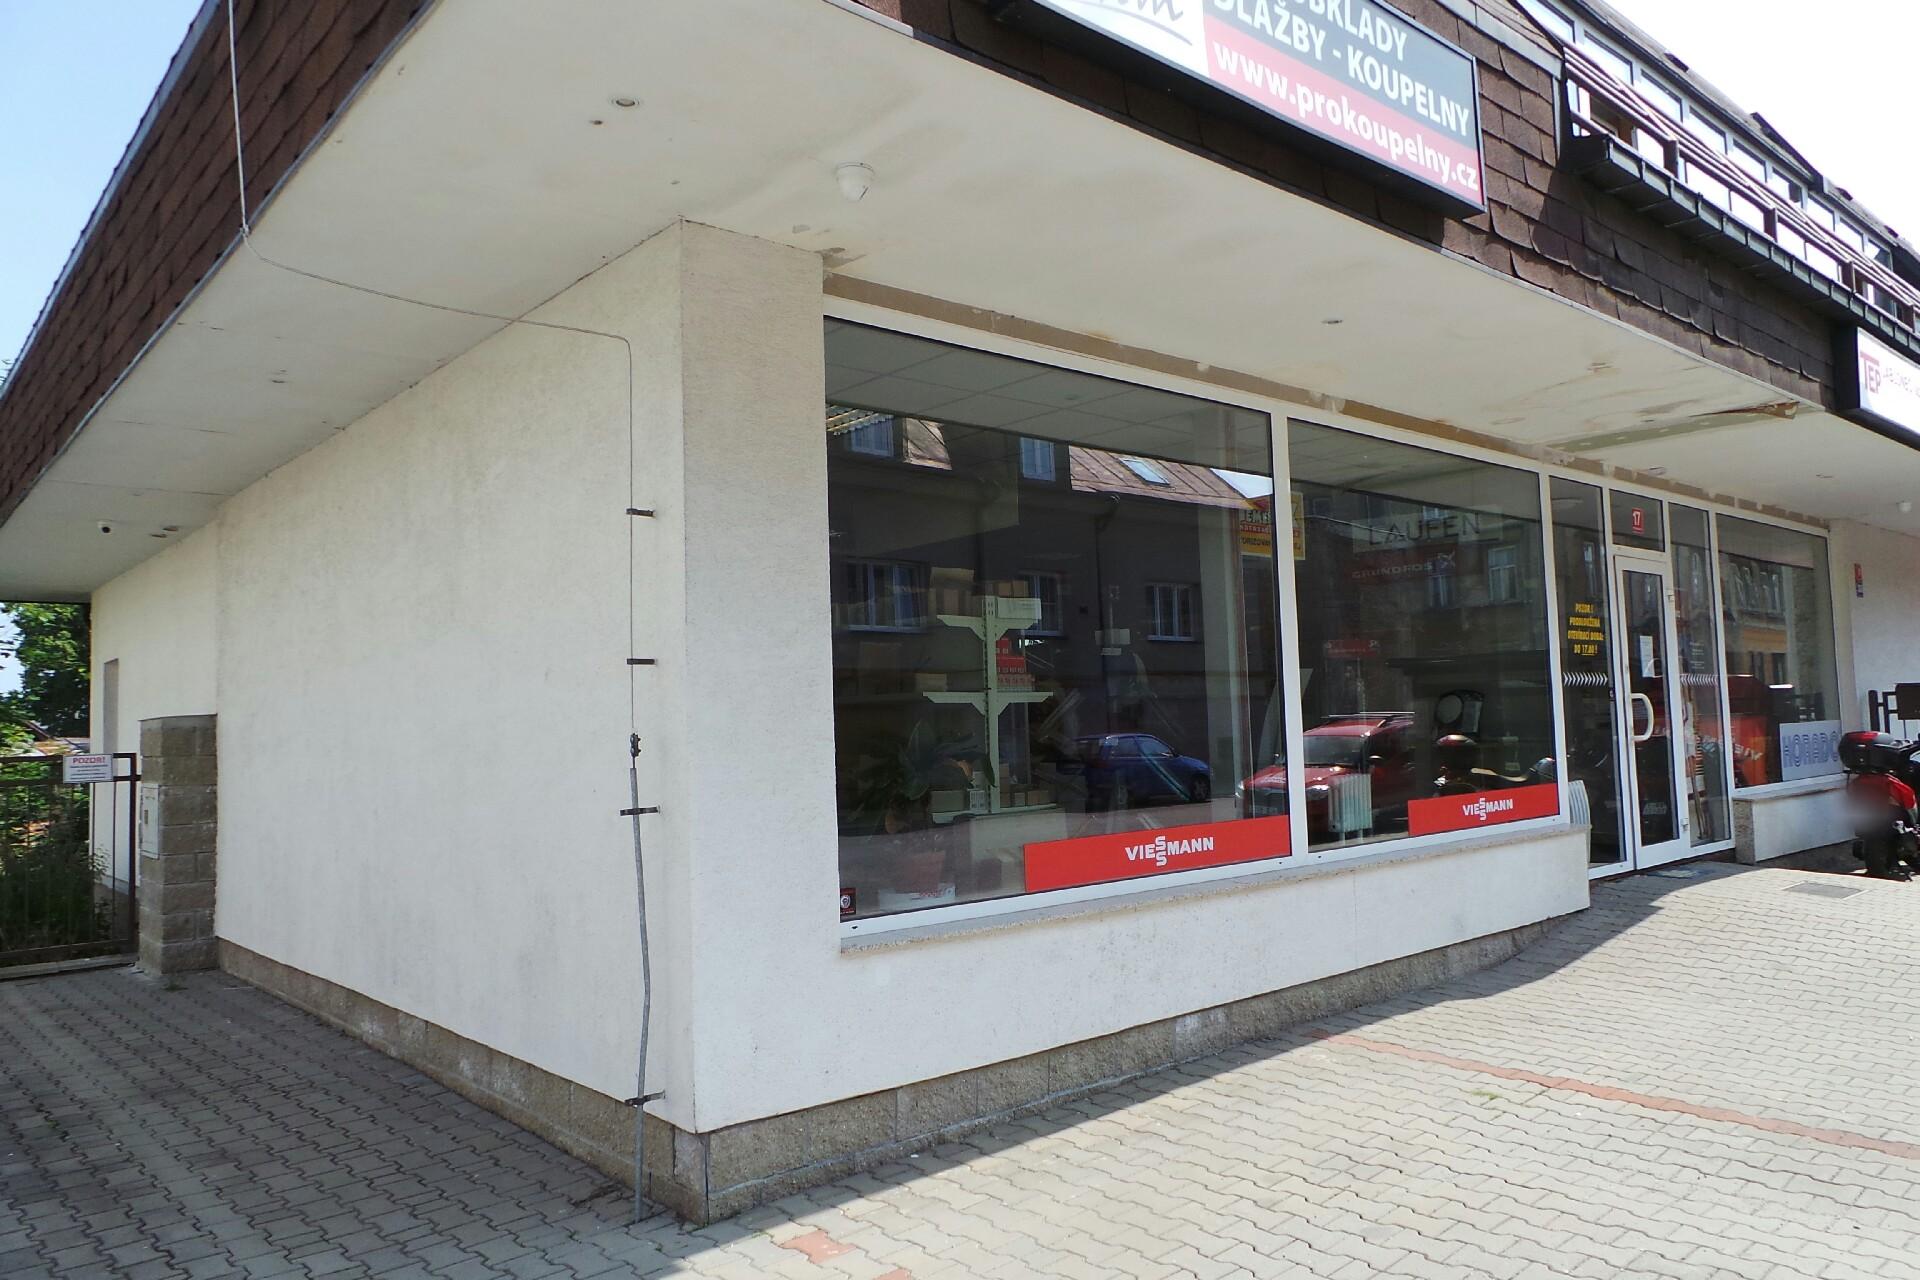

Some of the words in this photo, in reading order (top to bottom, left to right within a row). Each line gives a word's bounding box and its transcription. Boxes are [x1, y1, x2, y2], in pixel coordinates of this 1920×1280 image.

[1294, 0, 1407, 61] KLADY
[1332, 49, 1342, 58] -
[1347, 44, 1470, 137] KOUPELNY
[1212, 41, 1479, 191] www.prokoupelny.cz
[1368, 512, 1481, 546] LAUFEN
[1632, 511, 1641, 526] 17
[1351, 561, 1433, 579] GRUNDFOS
[72, 756, 106, 764] POZOR!
[1462, 797, 1514, 821] VIESSMANN
[1125, 835, 1214, 867] VIESSMANN
